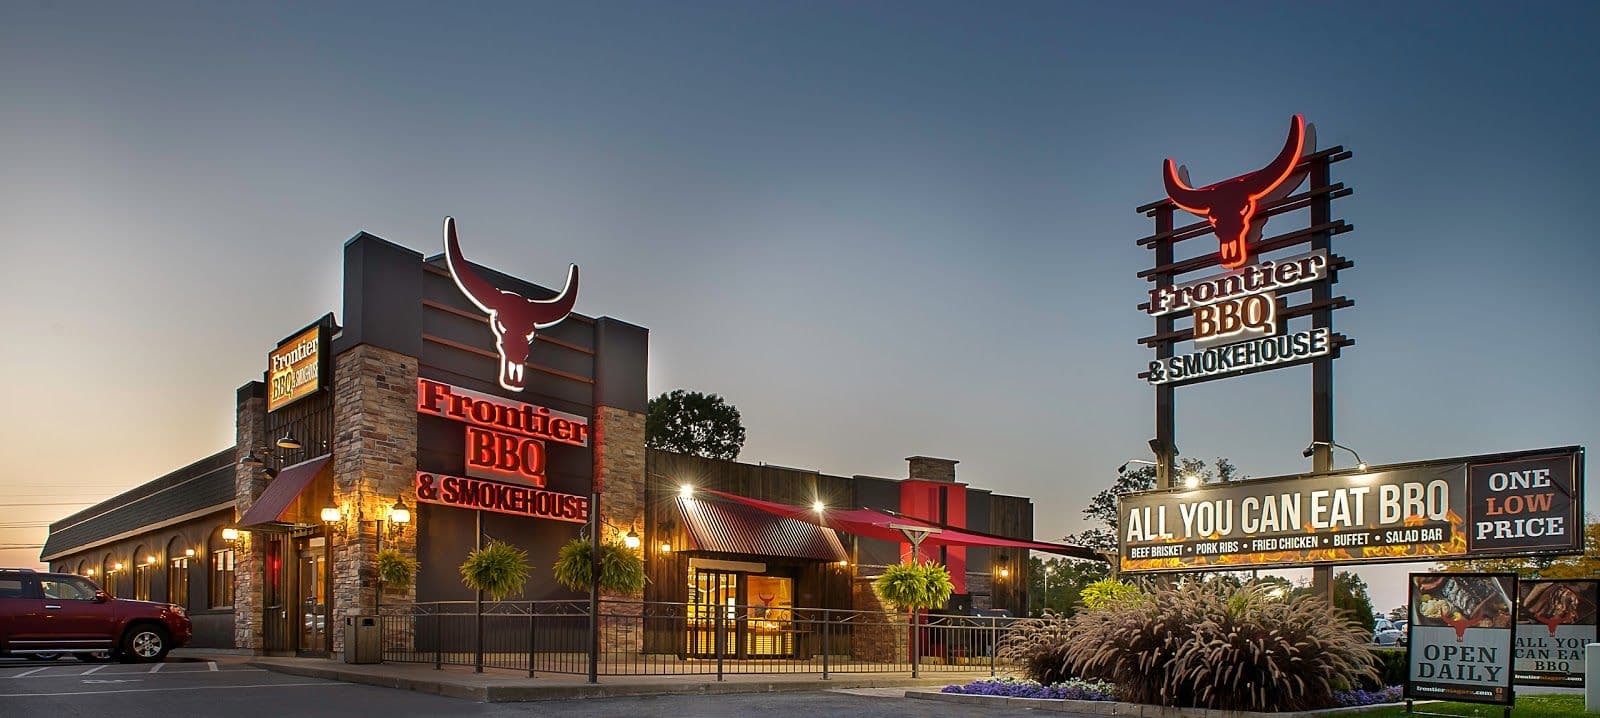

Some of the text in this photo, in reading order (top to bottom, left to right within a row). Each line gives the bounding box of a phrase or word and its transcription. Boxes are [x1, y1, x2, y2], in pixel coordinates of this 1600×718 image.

[1149, 255, 1324, 314] Frontier
[1193, 293, 1272, 339] BBQ
[271, 338, 318, 373] Frontier
[1149, 329, 1328, 382] & SMOKEHOUSE
[272, 371, 293, 400] BBQ
[420, 380, 588, 444] Frontier
[469, 428, 545, 487] BBQ
[1488, 468, 1551, 491] ONE
[417, 474, 588, 520] & SMOKEHOUSE
[1126, 479, 1450, 542] ALL YOU CAN EAT BBQ
[1486, 493, 1554, 516] LOW
[1131, 528, 1443, 559] BEEF BRISKET PORK RIBS FRIED CHICKEN BUFFET SALAD BAR
[1476, 517, 1564, 540] PRICE
[1423, 644, 1497, 664] OPEN
[1515, 637, 1592, 649] ALL YOU
[1515, 648, 1585, 660] CAN EA
[1418, 662, 1503, 683] DAILY
[1535, 660, 1570, 673] BBQ
